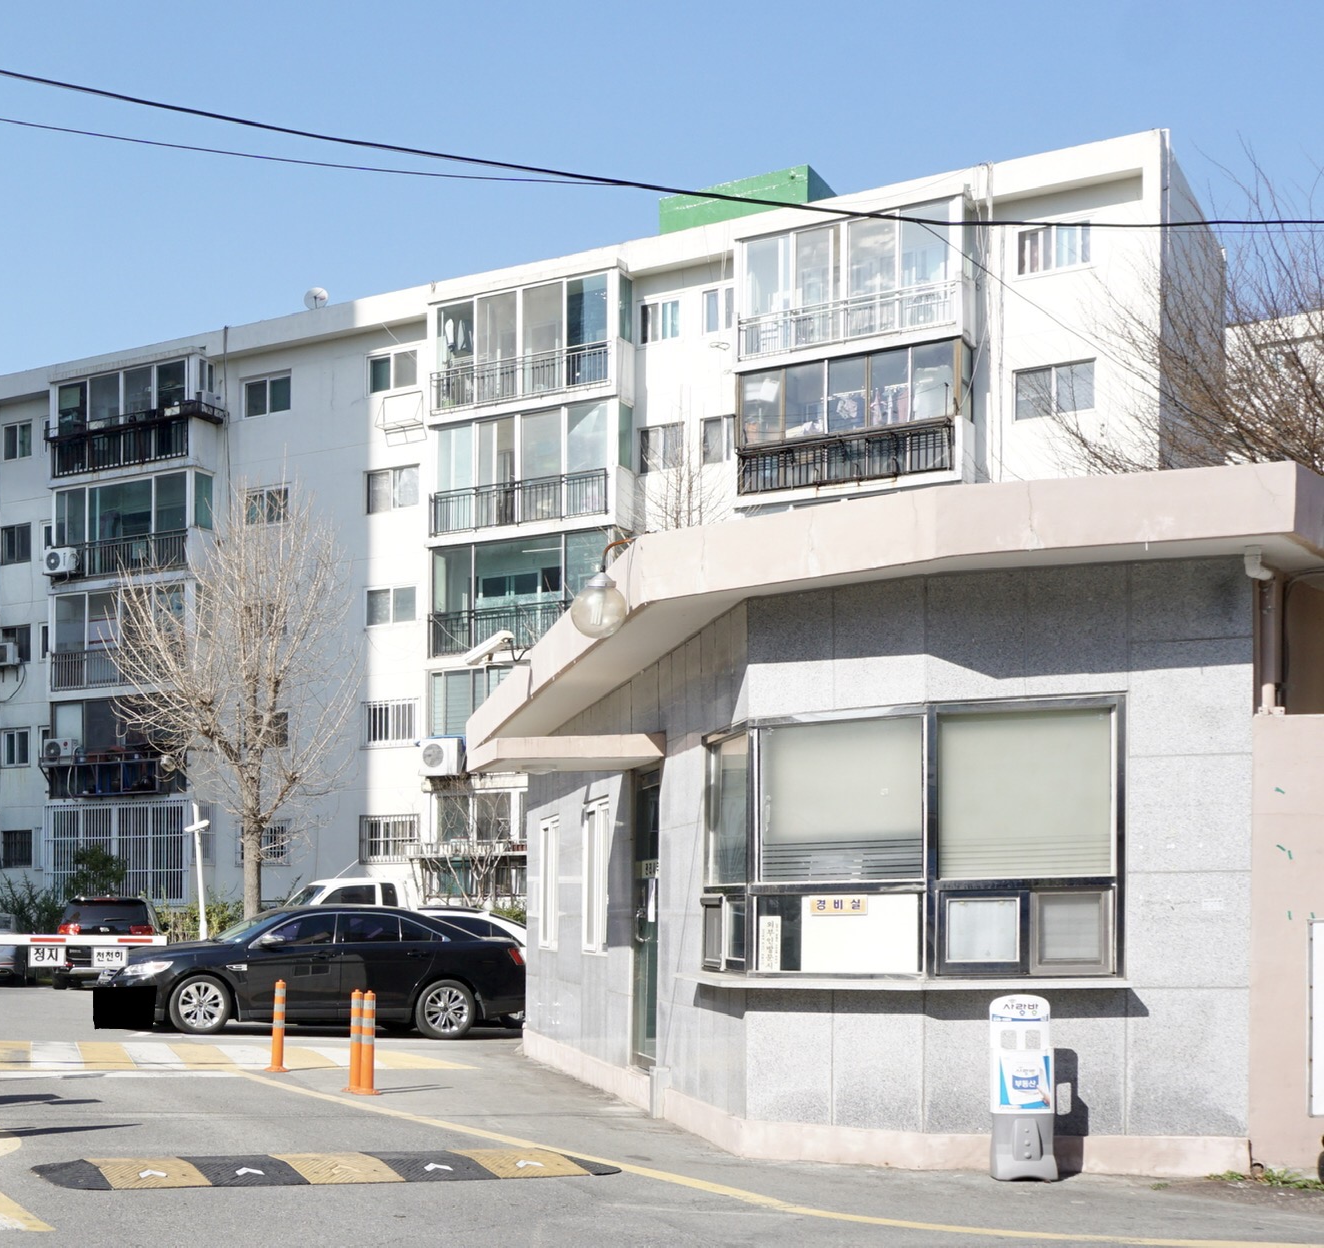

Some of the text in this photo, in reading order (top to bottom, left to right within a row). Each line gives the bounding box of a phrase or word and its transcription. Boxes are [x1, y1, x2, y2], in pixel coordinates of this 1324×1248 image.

[816, 898, 861, 911] 경비실
[33, 946, 58, 962] 정지
[1002, 1003, 1040, 1017] 사랑방
